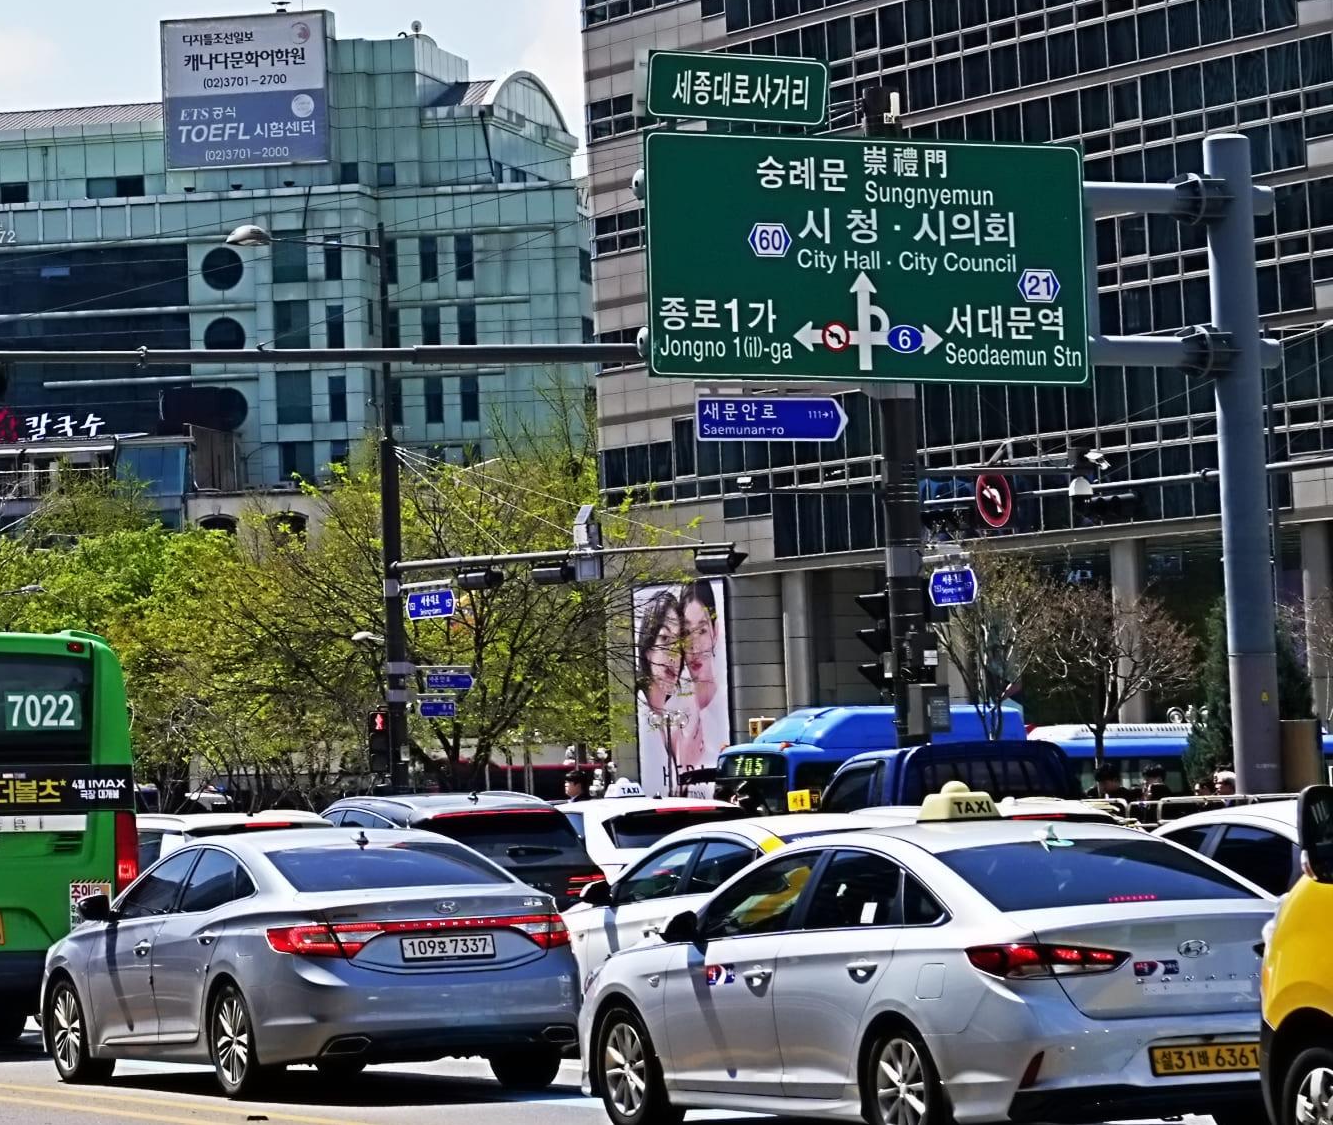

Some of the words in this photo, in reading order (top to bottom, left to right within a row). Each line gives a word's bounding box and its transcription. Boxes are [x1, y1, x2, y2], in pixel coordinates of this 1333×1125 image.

[182, 31, 254, 46] 디지틀조선일보
[184, 47, 306, 72] 캐나다문화어학원
[203, 74, 287, 89] (02)3701-2700
[672, 69, 809, 111] 세종대로사거리
[180, 108, 209, 120] ETS
[212, 106, 236, 120] 공식
[178, 123, 251, 143] TOEFL
[254, 120, 316, 138] 시험센터
[756, 155, 848, 192] 숭례문
[863, 146, 947, 178] 崇禮門
[865, 181, 994, 209] Sungnyemun
[759, 229, 783, 251] 60
[913, 210, 1016, 248] 시의회
[797, 249, 837, 273] City
[844, 251, 881, 270] Hall
[899, 251, 938, 275] City
[943, 252, 1016, 273] Council
[1028, 275, 1052, 297] 21
[659, 296, 777, 334] 종로1가
[945, 304, 1065, 340] 서대문역
[659, 335, 727, 362] Jongno
[733, 336, 794, 364] 1(il)-ga
[897, 329, 912, 349] 6
[945, 344, 1047, 367] Seodaemun
[1053, 346, 1082, 367] Stn
[703, 423, 785, 436] Saemunan-ro
[7, 693, 75, 727] 7022
[734, 757, 764, 777] 705
[80, 789, 96, 800] 극장
[98, 789, 120, 800] 대개봉
[88, 779, 126, 789] IMAX
[621, 787, 640, 795] TAXI
[953, 800, 993, 814] TAXI
[449, 937, 488, 954] 7337
[1214, 1046, 1259, 1068] 6361
